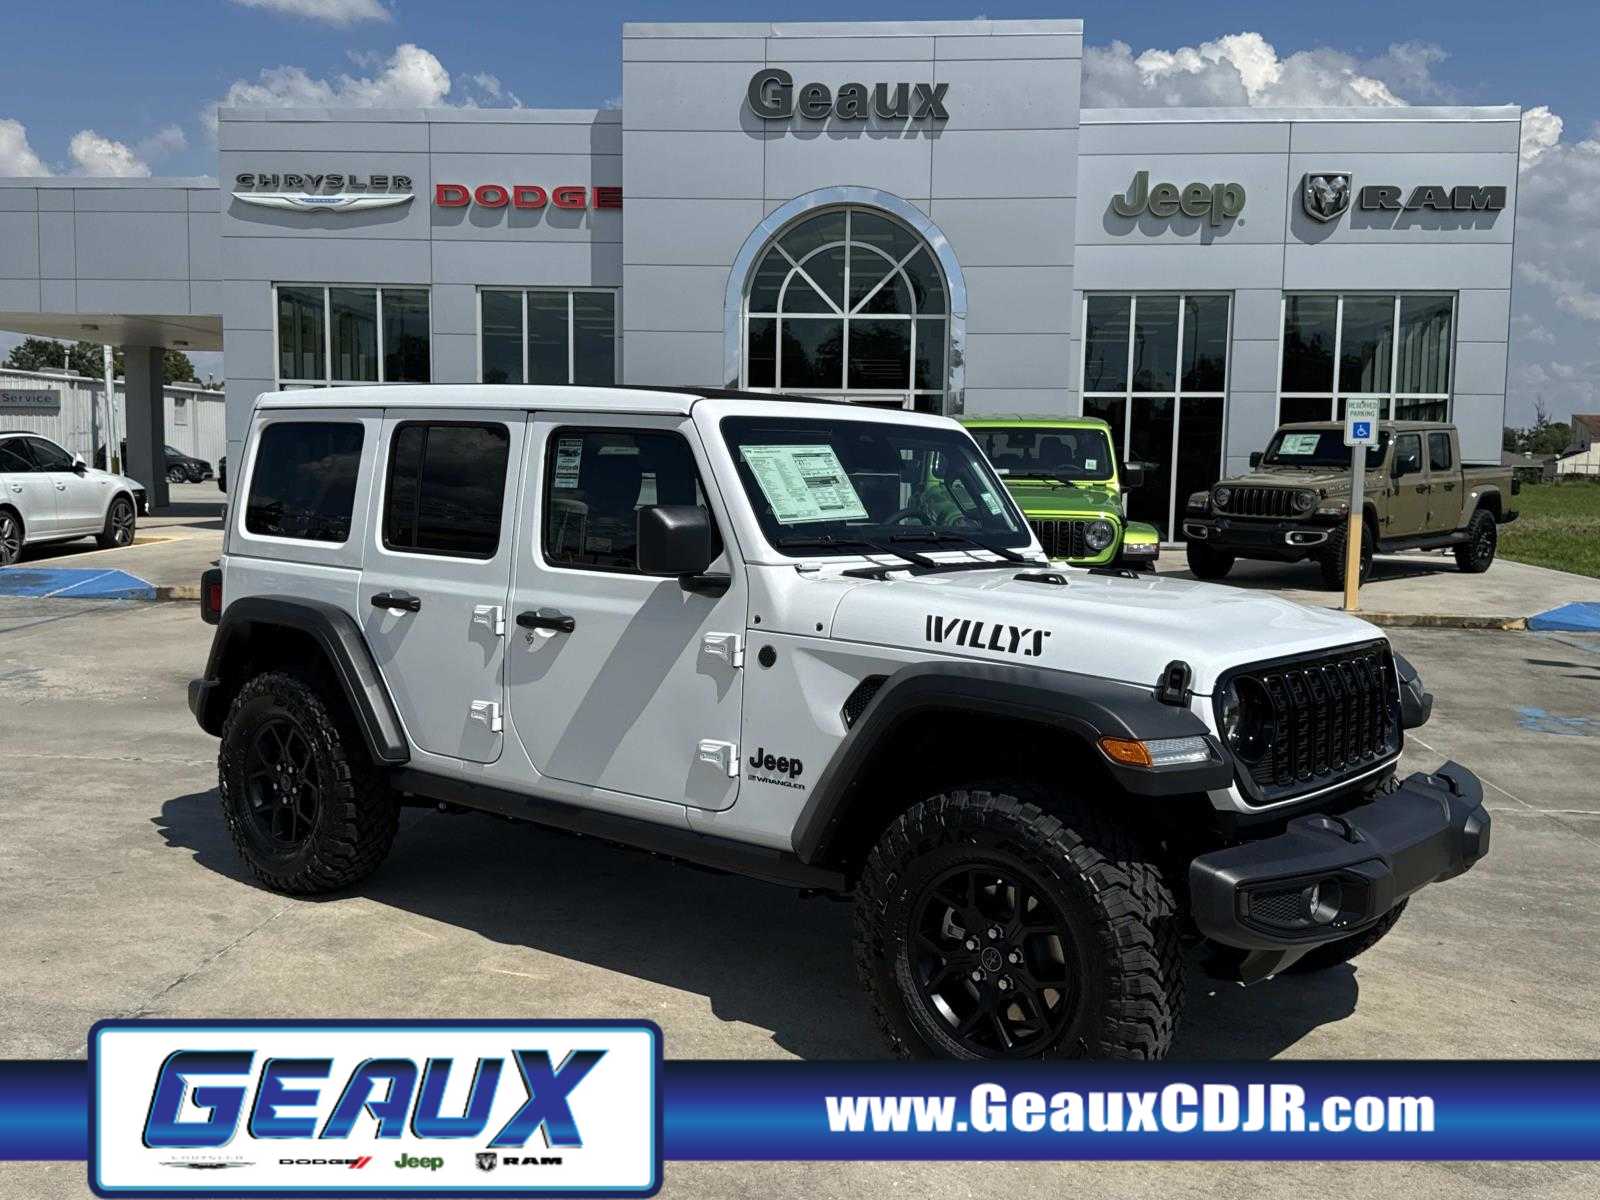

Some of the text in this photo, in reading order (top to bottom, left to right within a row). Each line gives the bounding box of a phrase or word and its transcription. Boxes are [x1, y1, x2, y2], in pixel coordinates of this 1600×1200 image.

[748, 68, 950, 120] Geaux
[236, 173, 413, 190] CHRYSLER
[435, 184, 623, 209] DODGE
[1112, 171, 1246, 226] Jeep
[1361, 185, 1507, 211] RAM
[2, 392, 52, 402] Service
[926, 615, 1051, 657] WILLYS
[749, 747, 803, 779] Jeep
